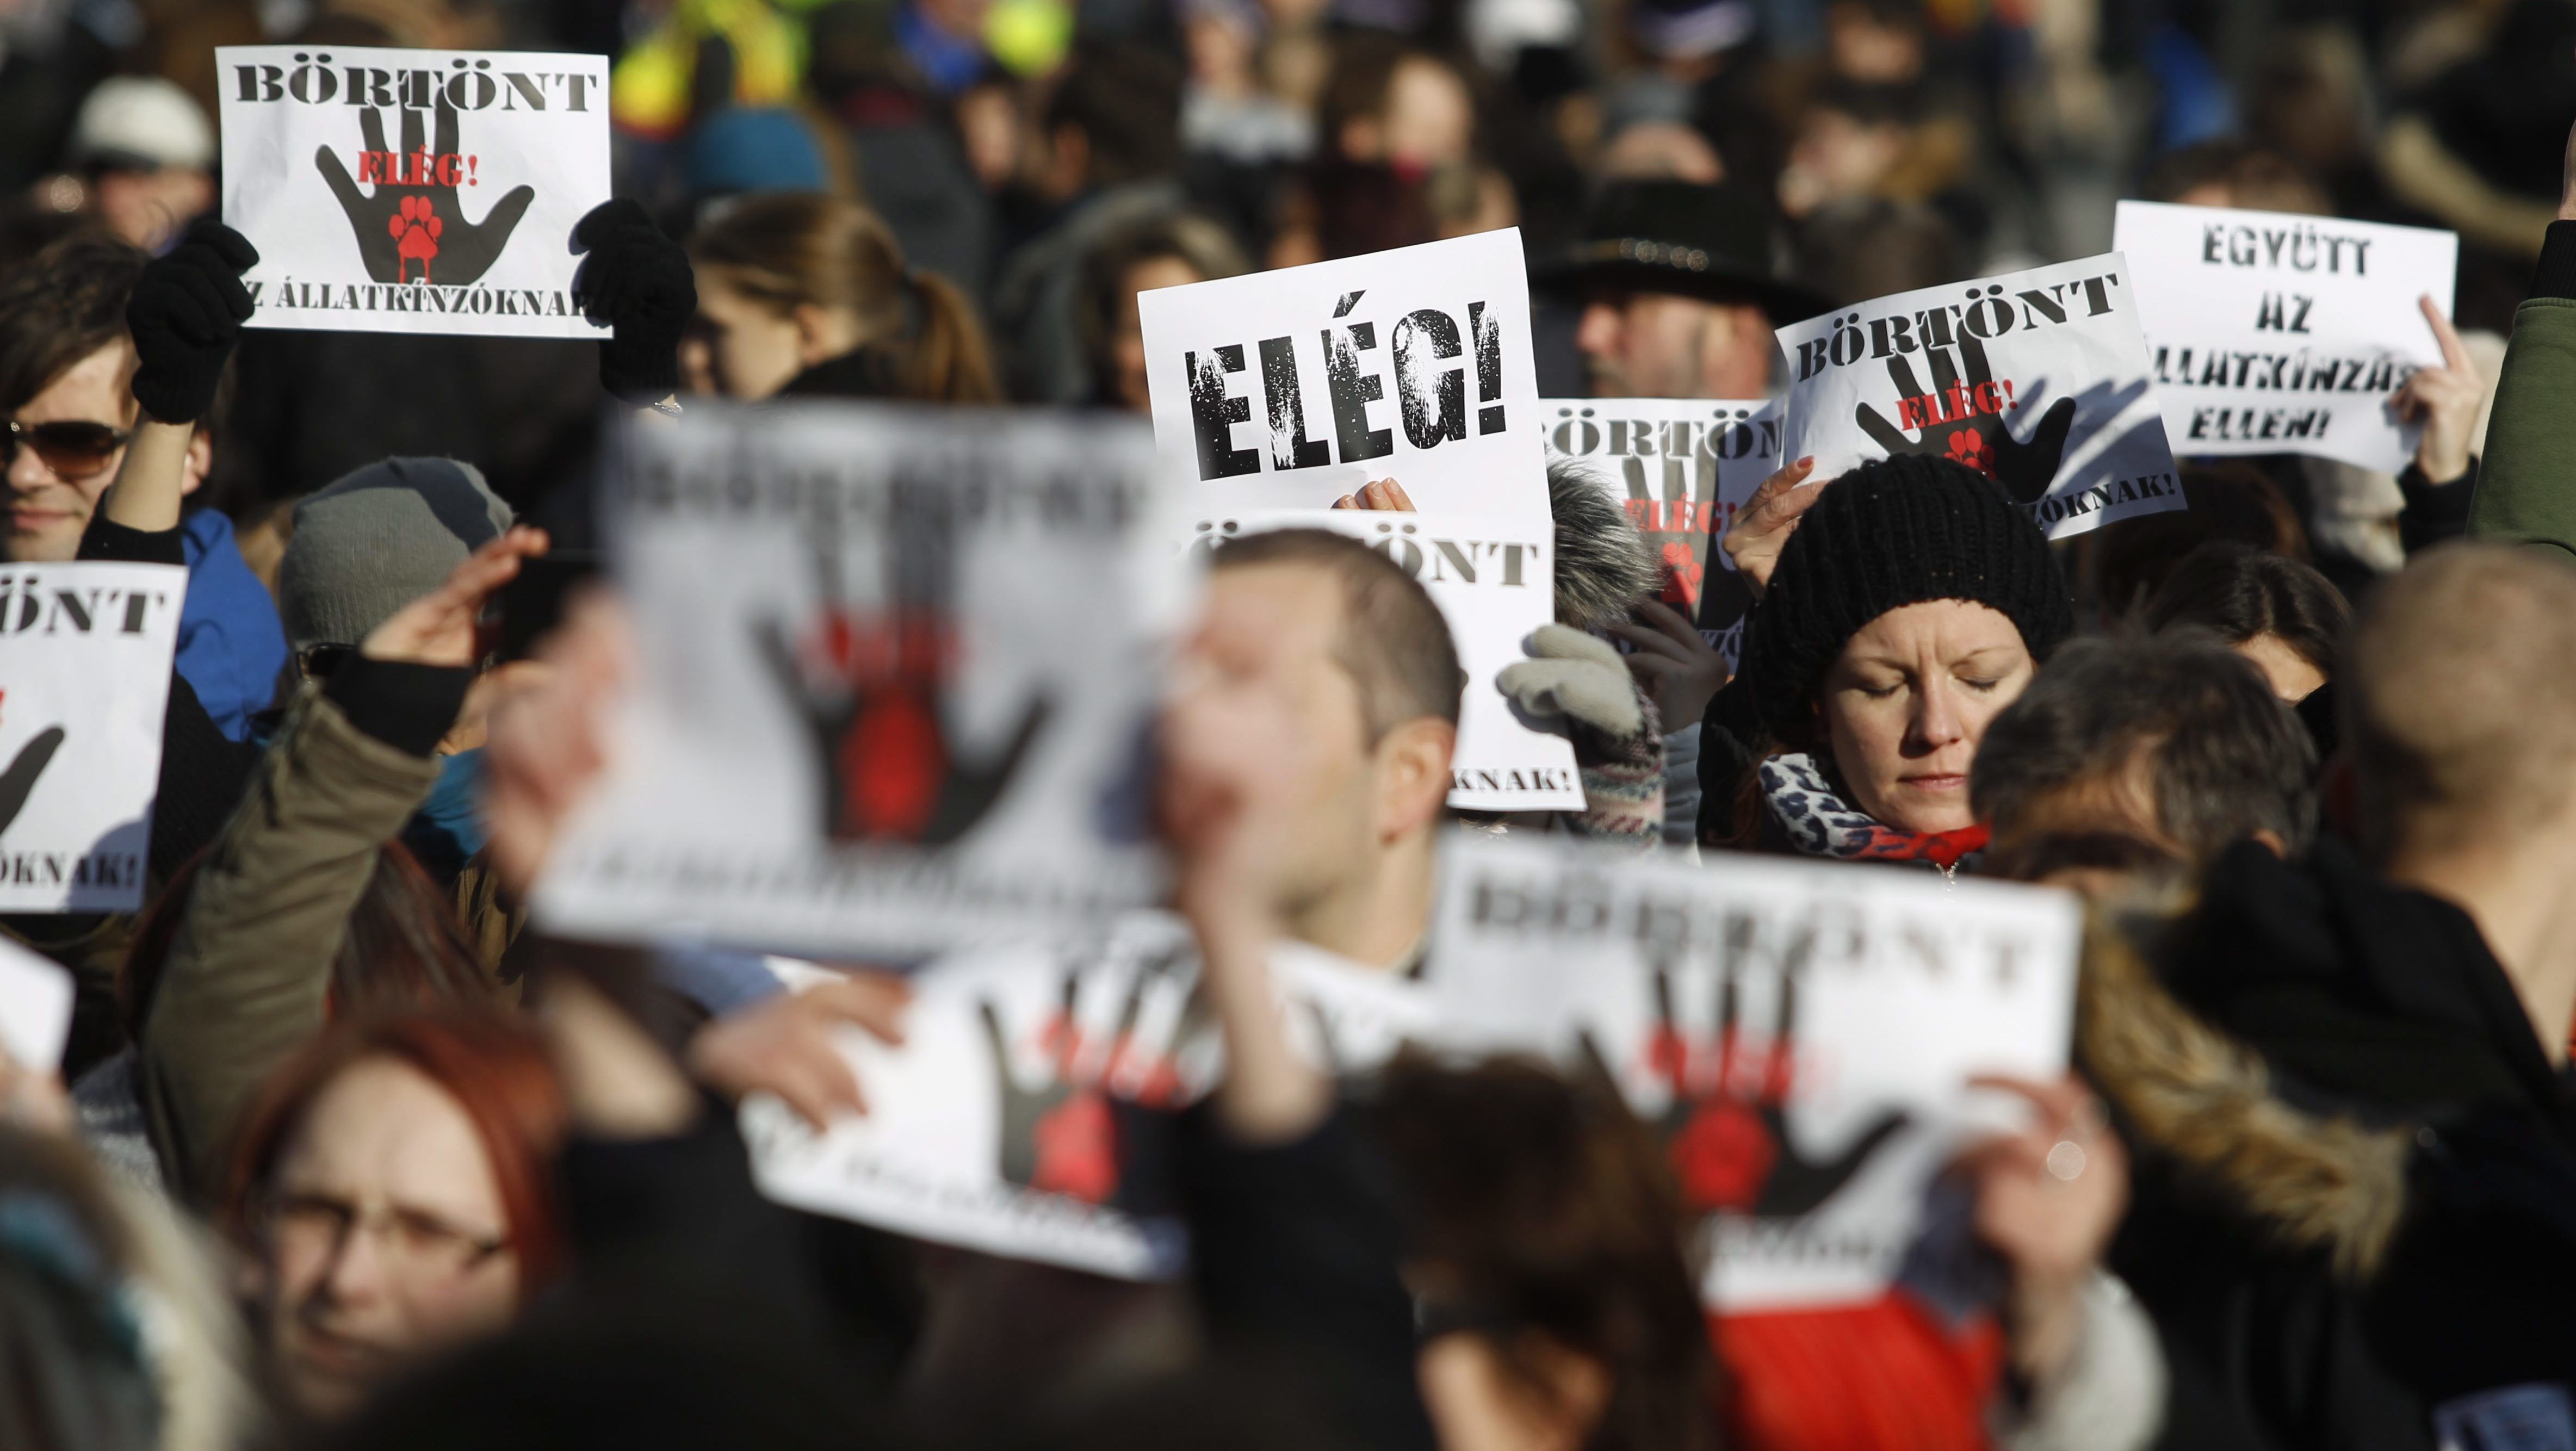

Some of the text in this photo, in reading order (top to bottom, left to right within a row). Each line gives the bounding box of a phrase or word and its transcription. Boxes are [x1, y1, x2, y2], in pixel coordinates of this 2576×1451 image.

[234, 53, 597, 111] BÖRTÖNT
[357, 144, 478, 187] ELÉG!
[2202, 223, 2370, 276] EGYÜTT
[246, 275, 585, 316] Z ÁLLATKÍNZÓKNA
[2255, 292, 2314, 332] AZ
[1797, 273, 2118, 382] BÖRTÖNT
[1185, 289, 1506, 481] ELÉG!
[2145, 335, 2418, 393] LLATKÍNZÁS
[1895, 368, 2018, 431] ELÉG!
[2187, 406, 2332, 439] ELLEN!
[1543, 407, 1782, 461] ÖRTÖN
[2036, 473, 2175, 524] ÓKNAK!
[0, 574, 168, 633] ÖNT
